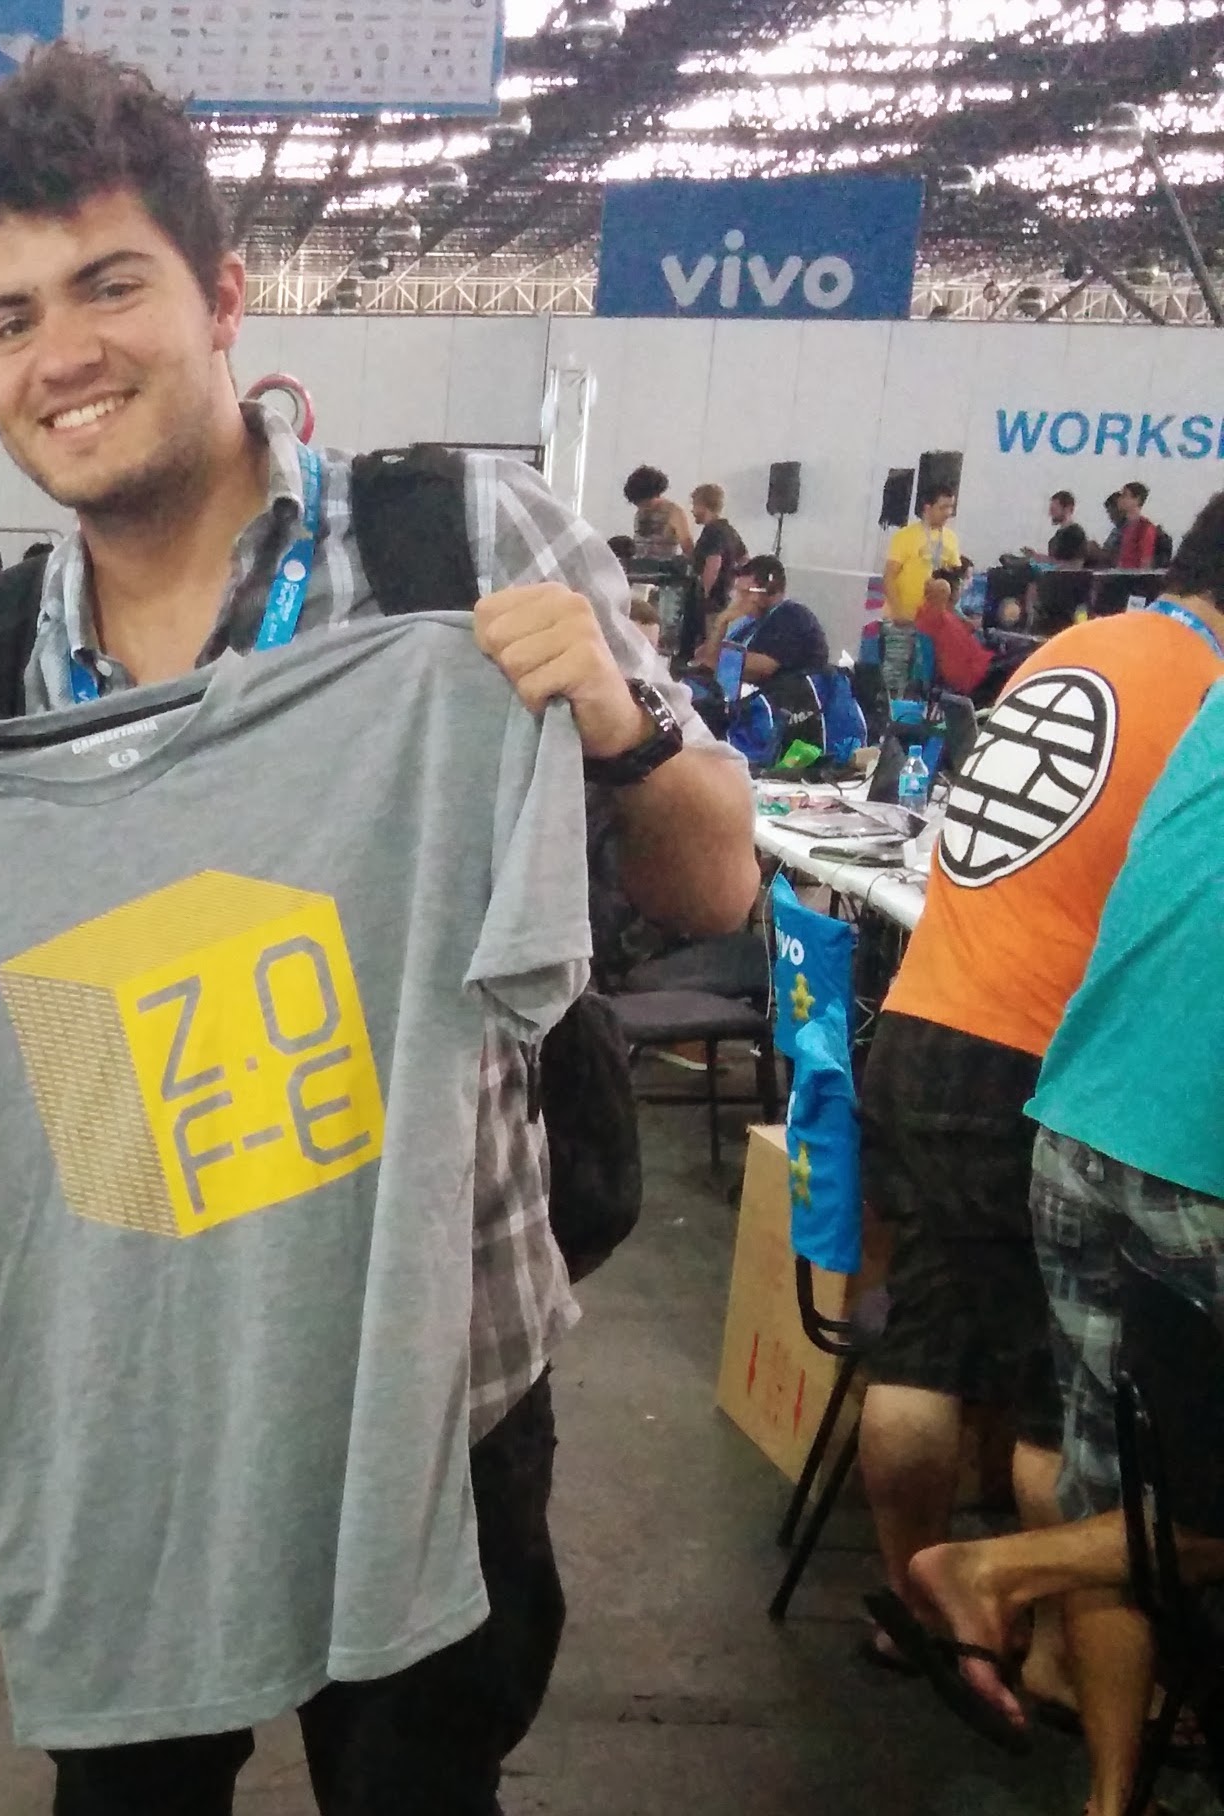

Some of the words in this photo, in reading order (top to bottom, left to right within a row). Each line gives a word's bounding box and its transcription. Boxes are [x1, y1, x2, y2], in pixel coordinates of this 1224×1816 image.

[661, 229, 855, 310] vivo
[996, 408, 1224, 460] WORKS
[117, 750, 132, 764] G
